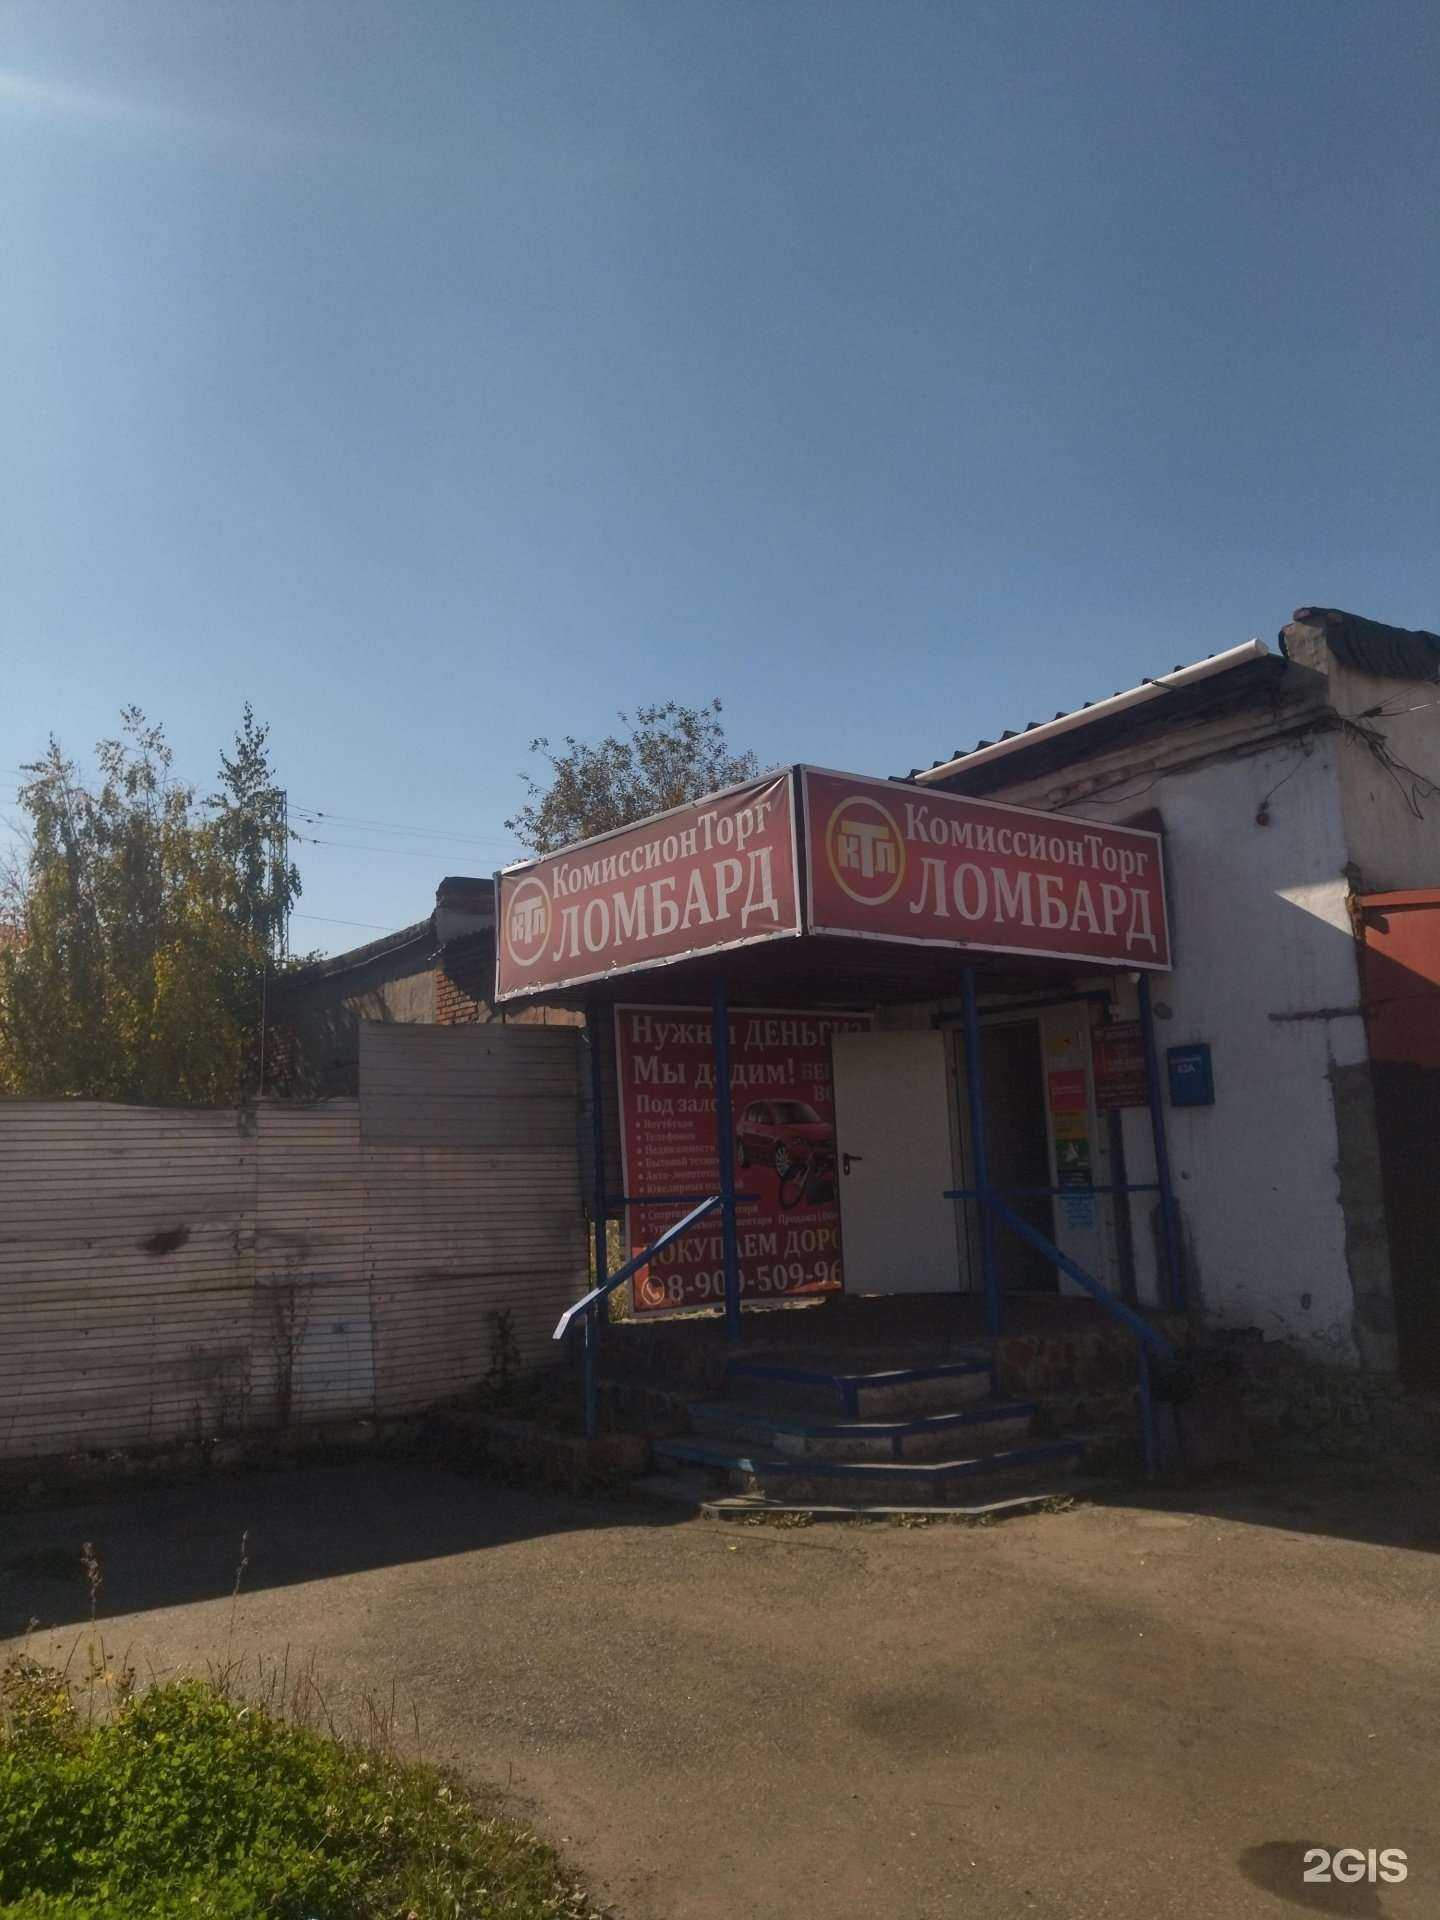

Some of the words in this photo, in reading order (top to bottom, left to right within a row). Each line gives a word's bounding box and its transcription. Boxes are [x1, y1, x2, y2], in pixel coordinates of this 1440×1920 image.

[551, 801, 772, 899] КомиссионТорг
[904, 803, 1148, 883] КомиссионТорг
[552, 846, 779, 962] ЛОМБАРД
[909, 857, 1157, 953] ЛОМБАРД
[633, 1055, 689, 1085] Мы
[694, 1056, 796, 1090] ддим!
[636, 1094, 674, 1116] Под
